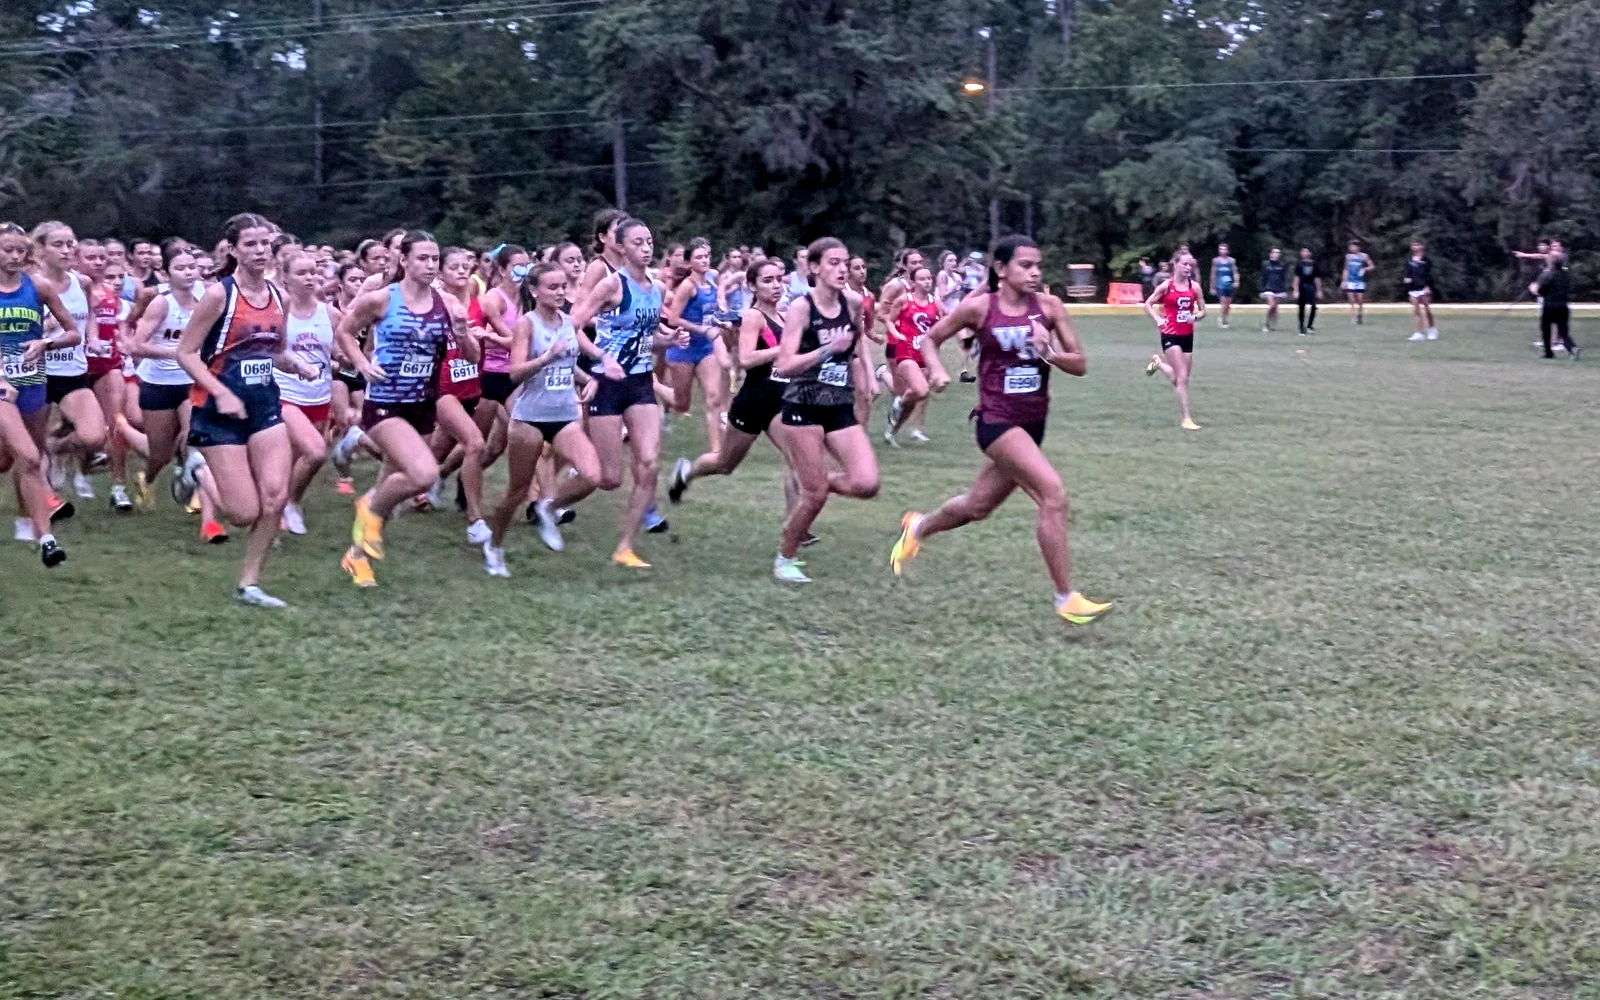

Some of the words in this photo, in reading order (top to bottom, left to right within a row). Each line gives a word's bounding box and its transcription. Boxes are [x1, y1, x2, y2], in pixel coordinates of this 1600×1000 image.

[244, 362, 271, 375] 0699
[403, 363, 432, 374] 6671
[453, 366, 476, 378] 6911
[820, 370, 846, 382] 5864
